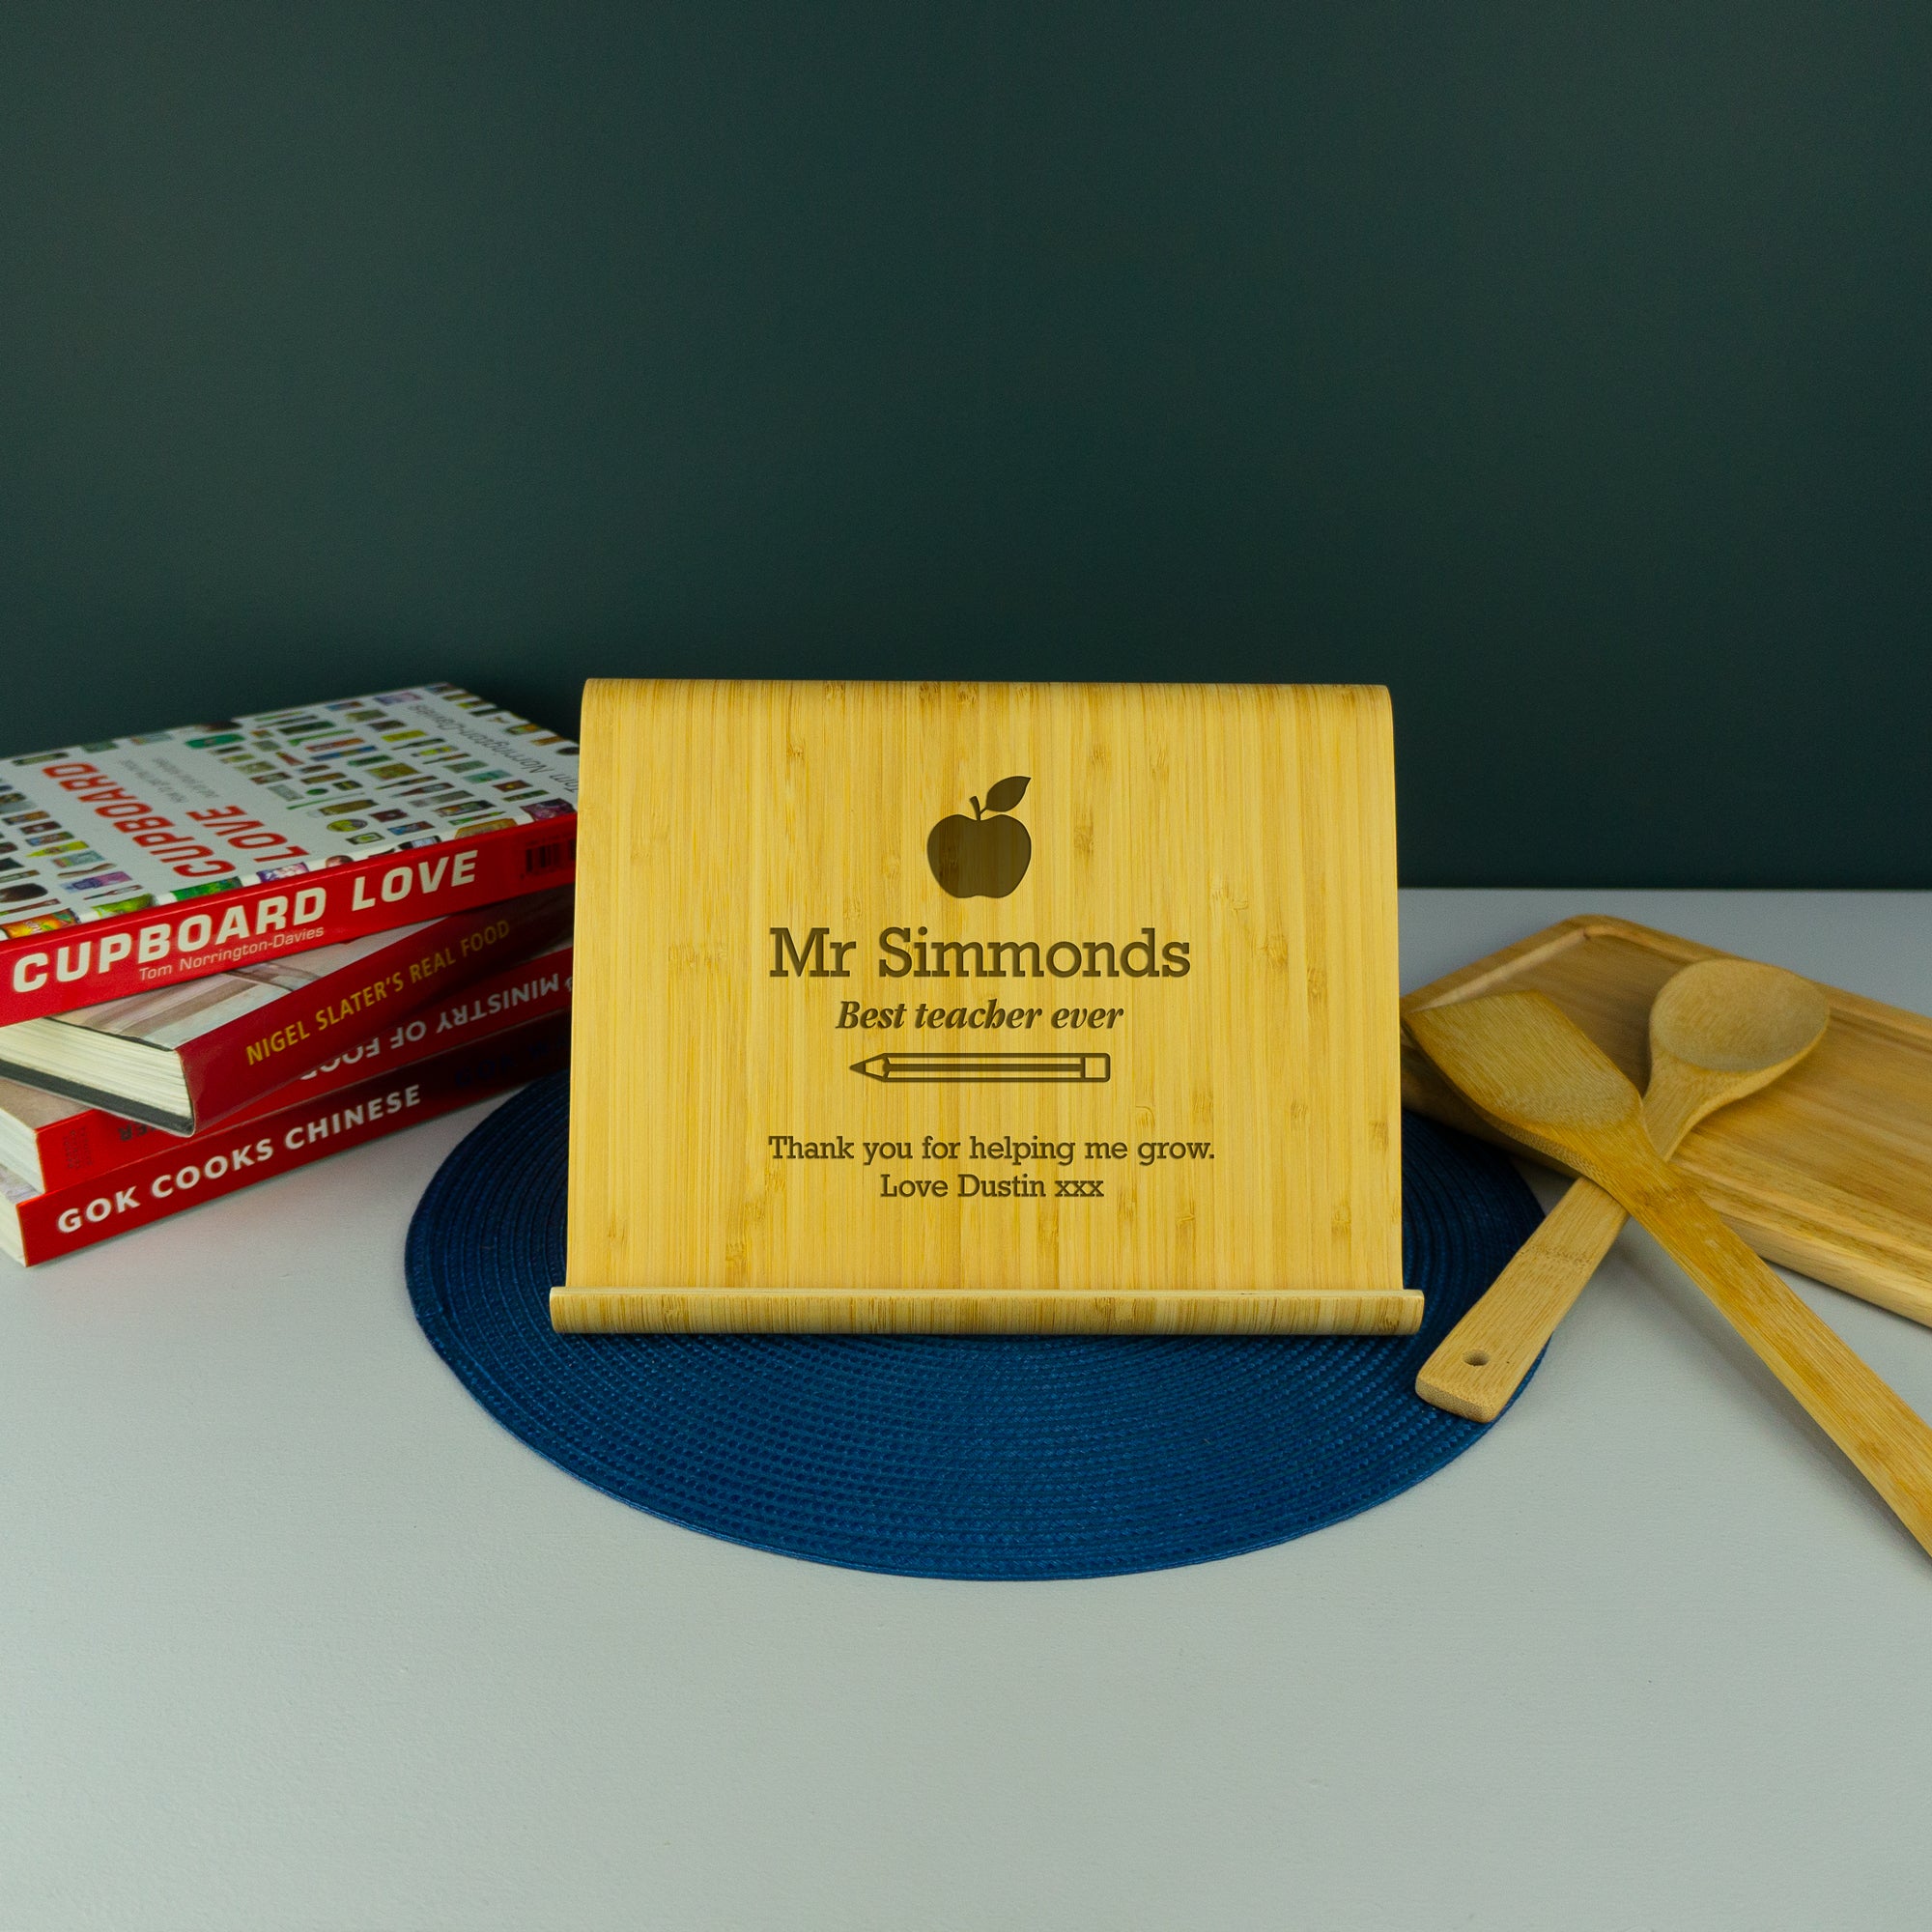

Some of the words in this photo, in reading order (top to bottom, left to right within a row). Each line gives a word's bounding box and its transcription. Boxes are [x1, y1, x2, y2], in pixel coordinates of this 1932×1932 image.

[43, 762, 236, 877] CUPBOARD
[185, 805, 310, 863] LOVE
[13, 887, 327, 993] CUPBOARD
[352, 849, 478, 912] LOVE
[139, 964, 172, 981] Tom
[180, 926, 325, 971] Norrington-Davies
[769, 926, 857, 978] Mr
[878, 925, 1191, 979] Simmonds
[245, 1021, 310, 1065] NIGEL
[315, 972, 404, 1031] SLATER'S
[409, 948, 456, 983] REAL
[459, 919, 511, 957] FOOD
[437, 974, 558, 1034] MINISTRY
[836, 1001, 905, 1030] Best
[914, 998, 1043, 1030] teacher
[1050, 1008, 1124, 1030] ever
[389, 1020, 428, 1049] OF
[57, 1185, 141, 1234] GOK
[151, 1138, 274, 1199] COOKS
[283, 1085, 420, 1150] CHINESE
[768, 1135, 855, 1159] Thank
[862, 1141, 914, 1166] you
[922, 1135, 961, 1160] for
[969, 1135, 1076, 1167] helping
[1084, 1142, 1128, 1160] me
[1137, 1142, 1215, 1167] grow.
[880, 1173, 949, 1198] Love
[957, 1173, 1047, 1198] Dustin
[1054, 1179, 1105, 1198] xxx
